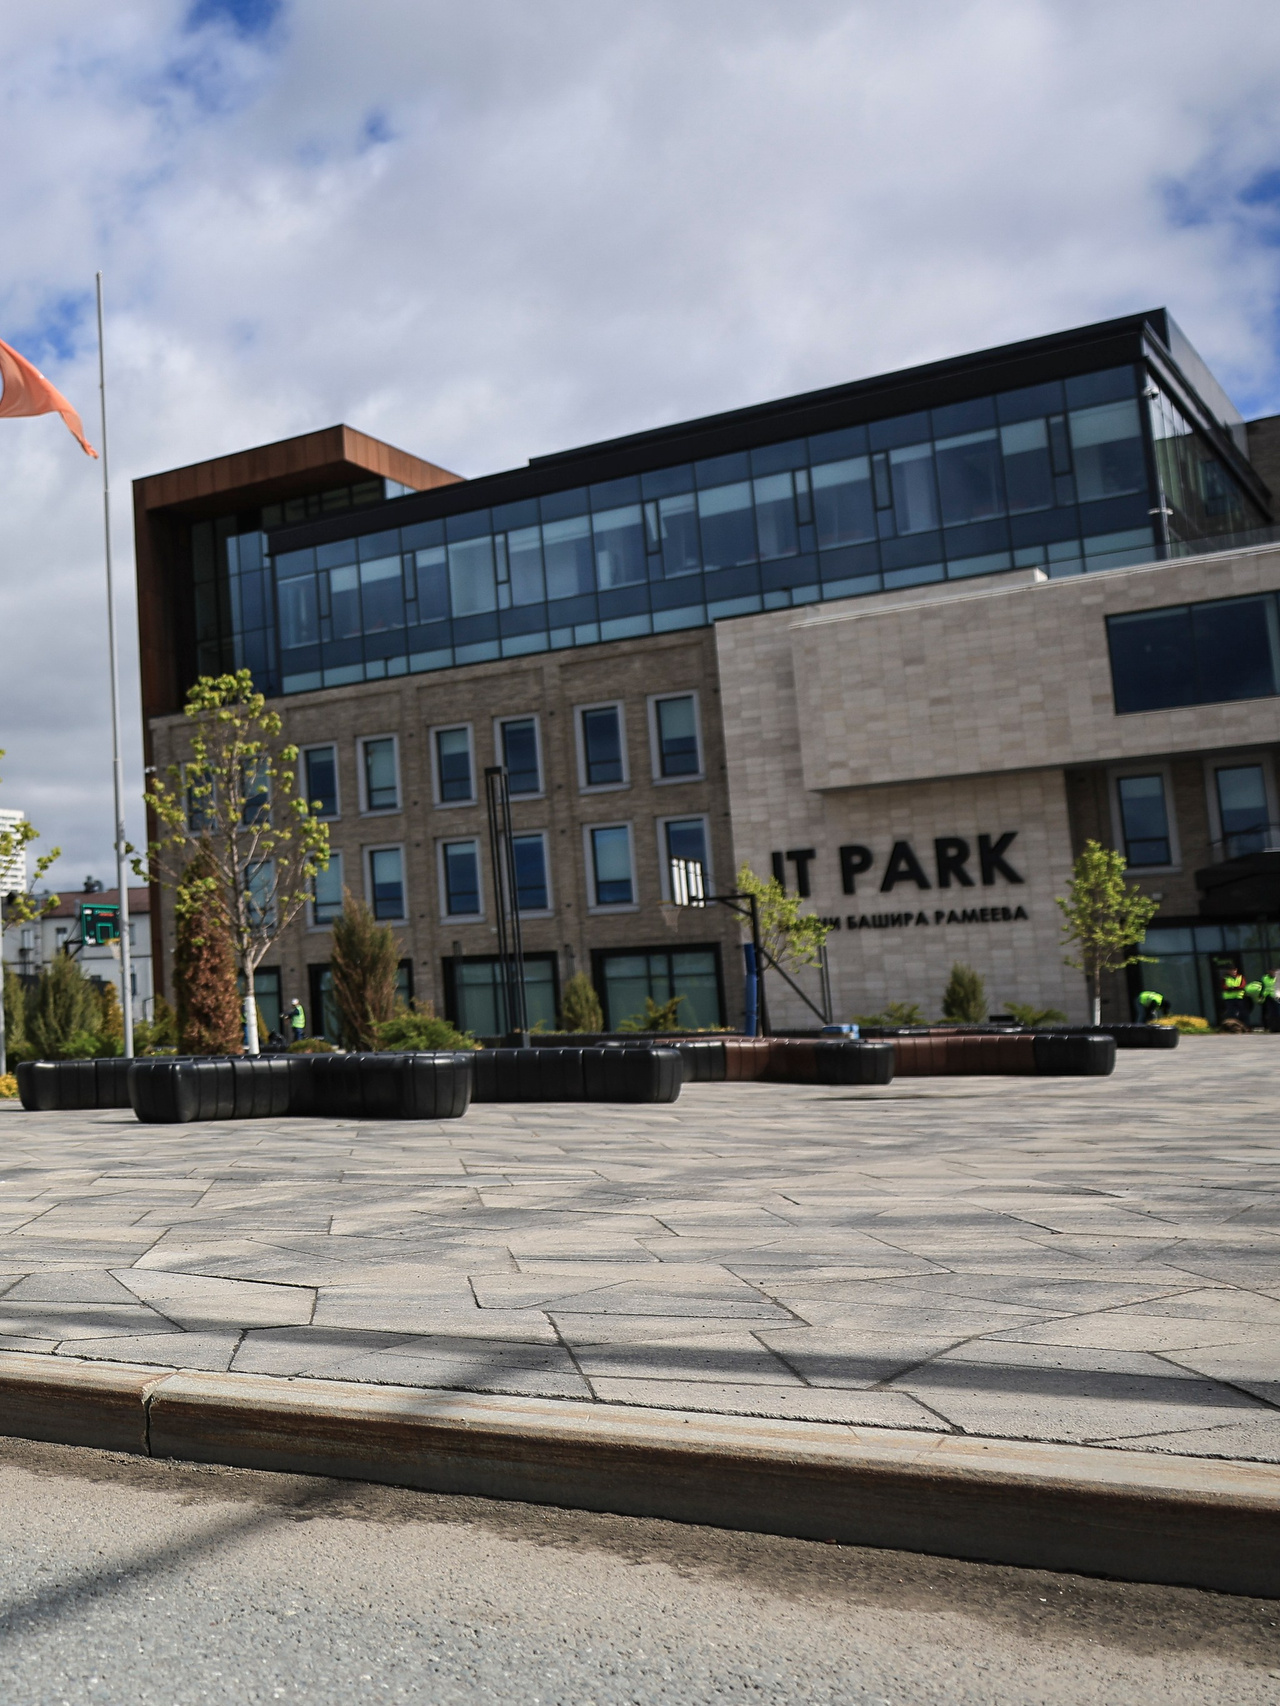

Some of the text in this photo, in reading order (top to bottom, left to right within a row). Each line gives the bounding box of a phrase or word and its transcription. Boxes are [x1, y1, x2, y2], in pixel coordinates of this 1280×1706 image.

[771, 830, 1025, 898] IT PARK
[846, 910, 929, 931] БАШИРА
[934, 904, 1029, 926] РАМЕЕВА
